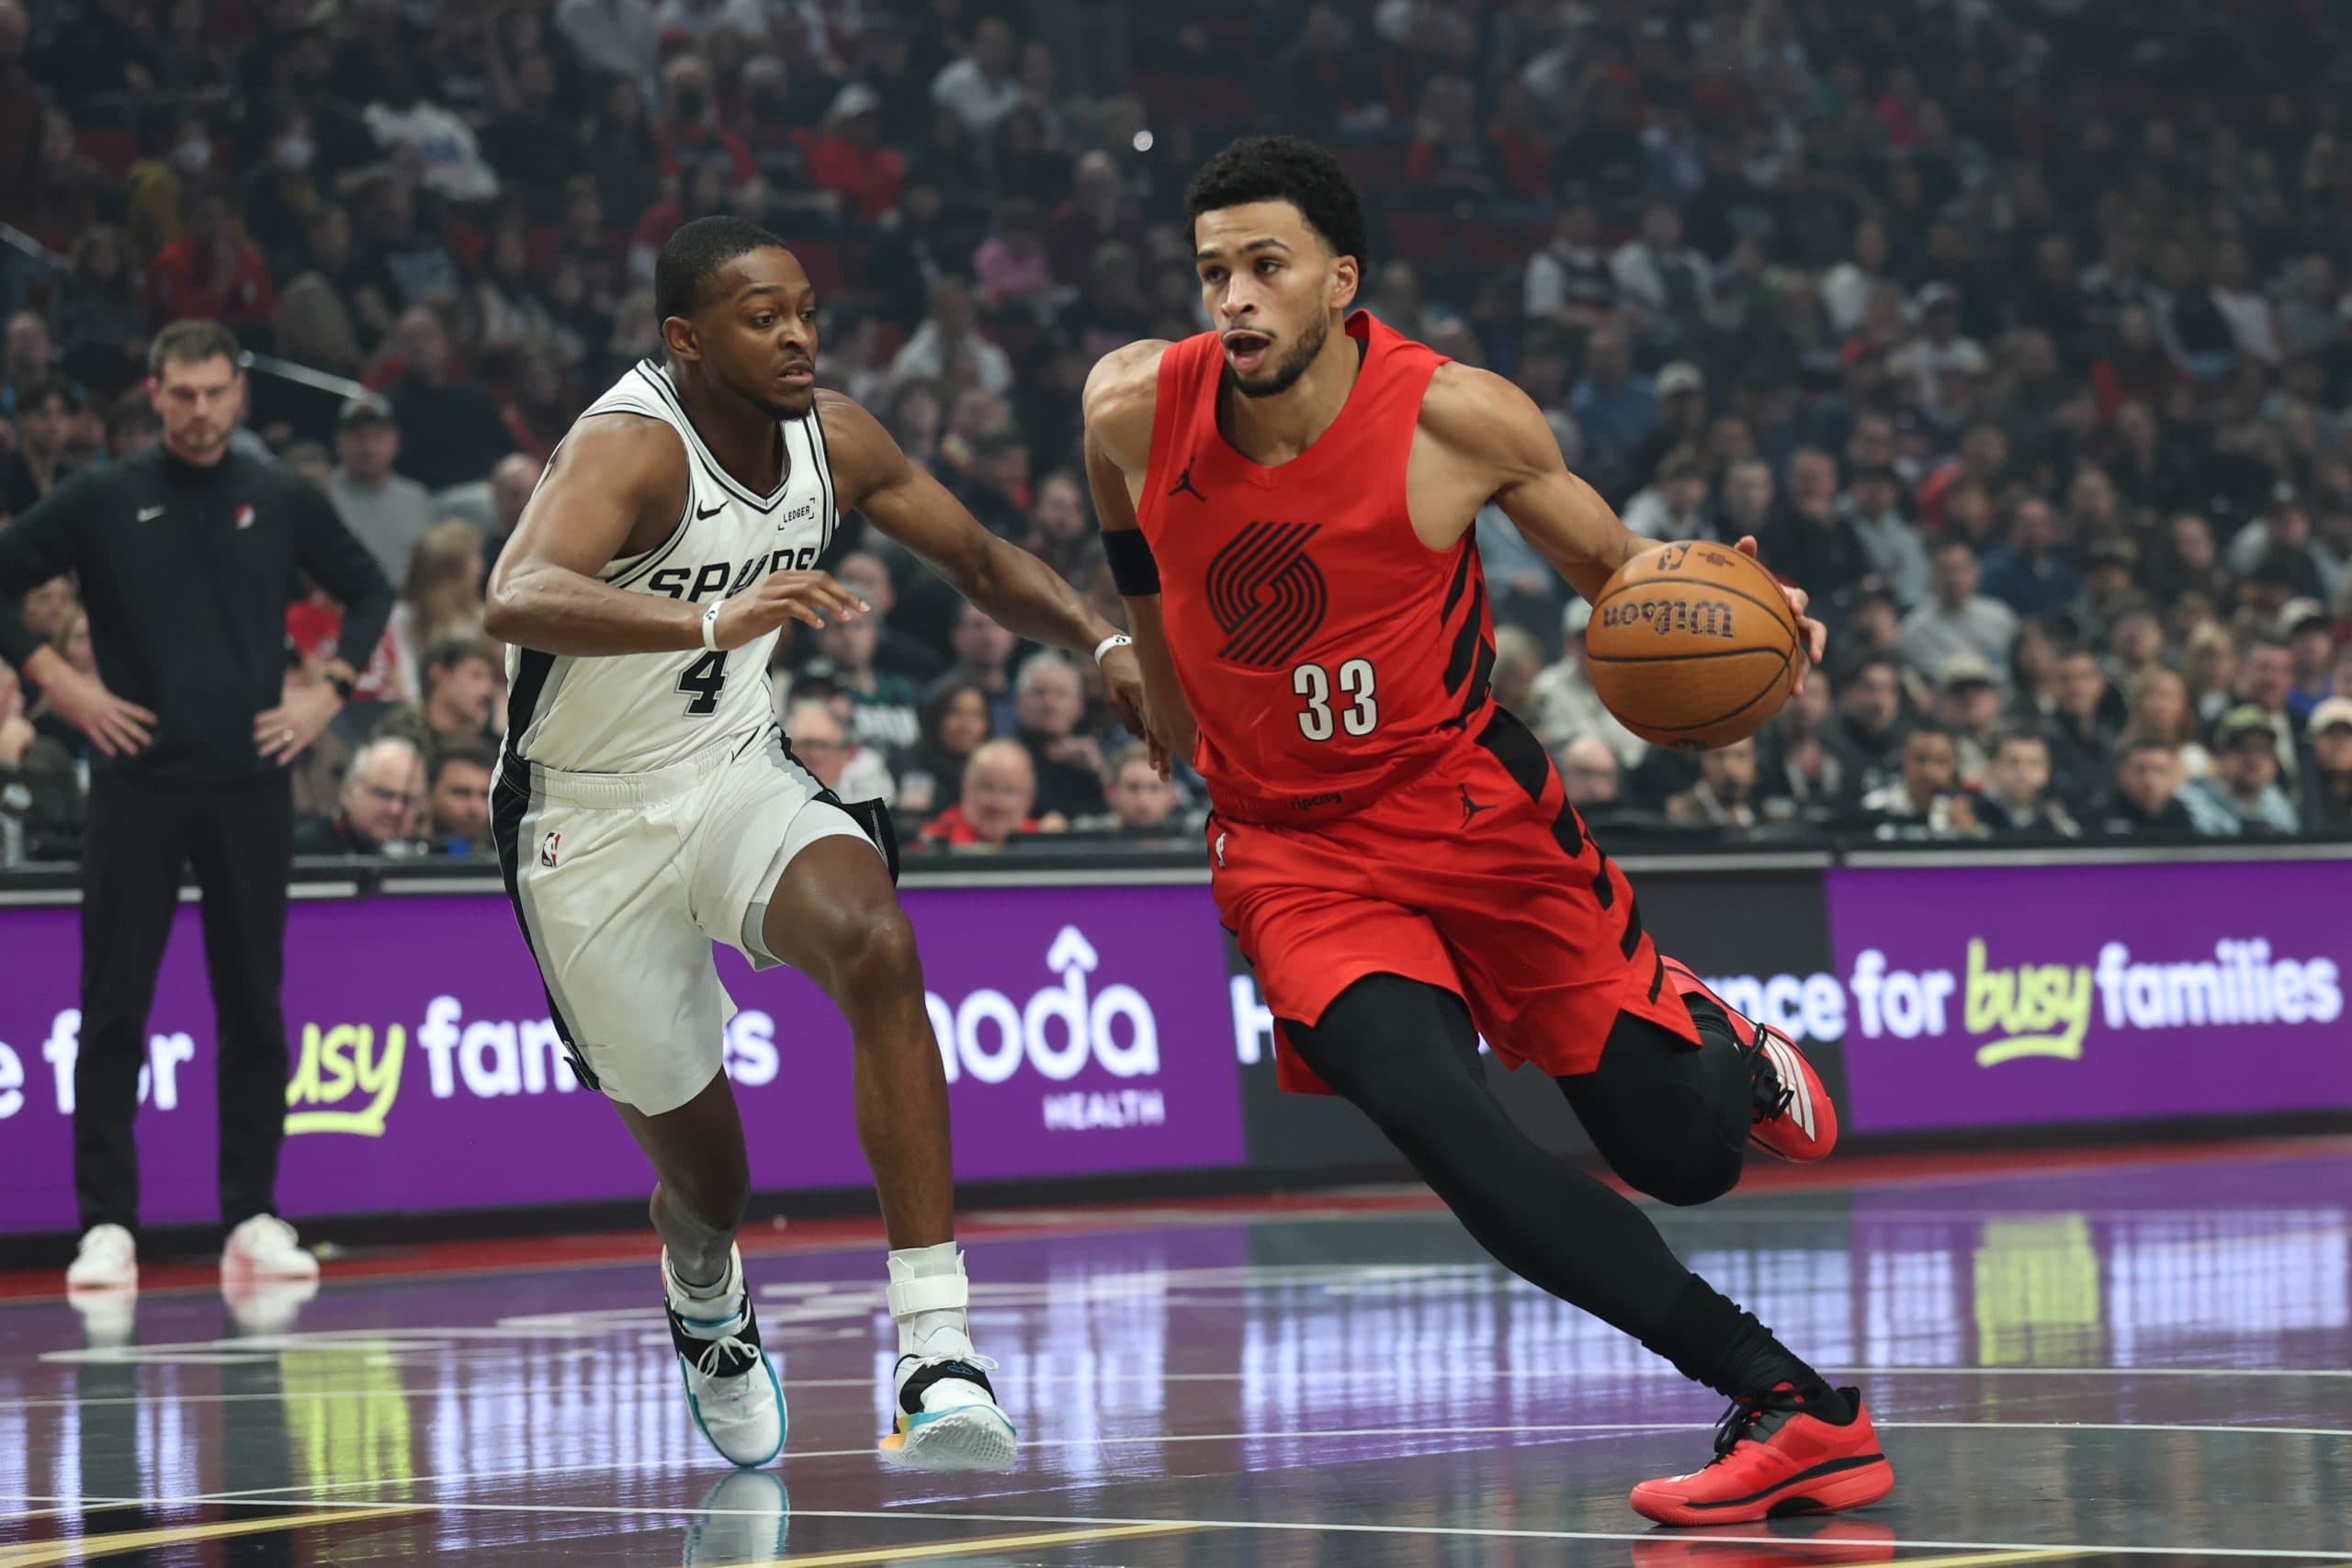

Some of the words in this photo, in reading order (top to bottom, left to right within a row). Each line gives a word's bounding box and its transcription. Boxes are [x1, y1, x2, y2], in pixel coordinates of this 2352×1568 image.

[783, 506, 810, 523] LEDGER
[1603, 600, 1736, 638] Wilson
[675, 650, 729, 716] 4
[1293, 659, 1378, 741] 33
[1849, 948, 1955, 1039] for
[1965, 937, 2093, 1067] busy
[2096, 937, 2344, 1030] families
[42, 1008, 195, 1115] fr
[283, 1021, 407, 1137] usy
[1042, 1089, 1165, 1131] HEALTH
